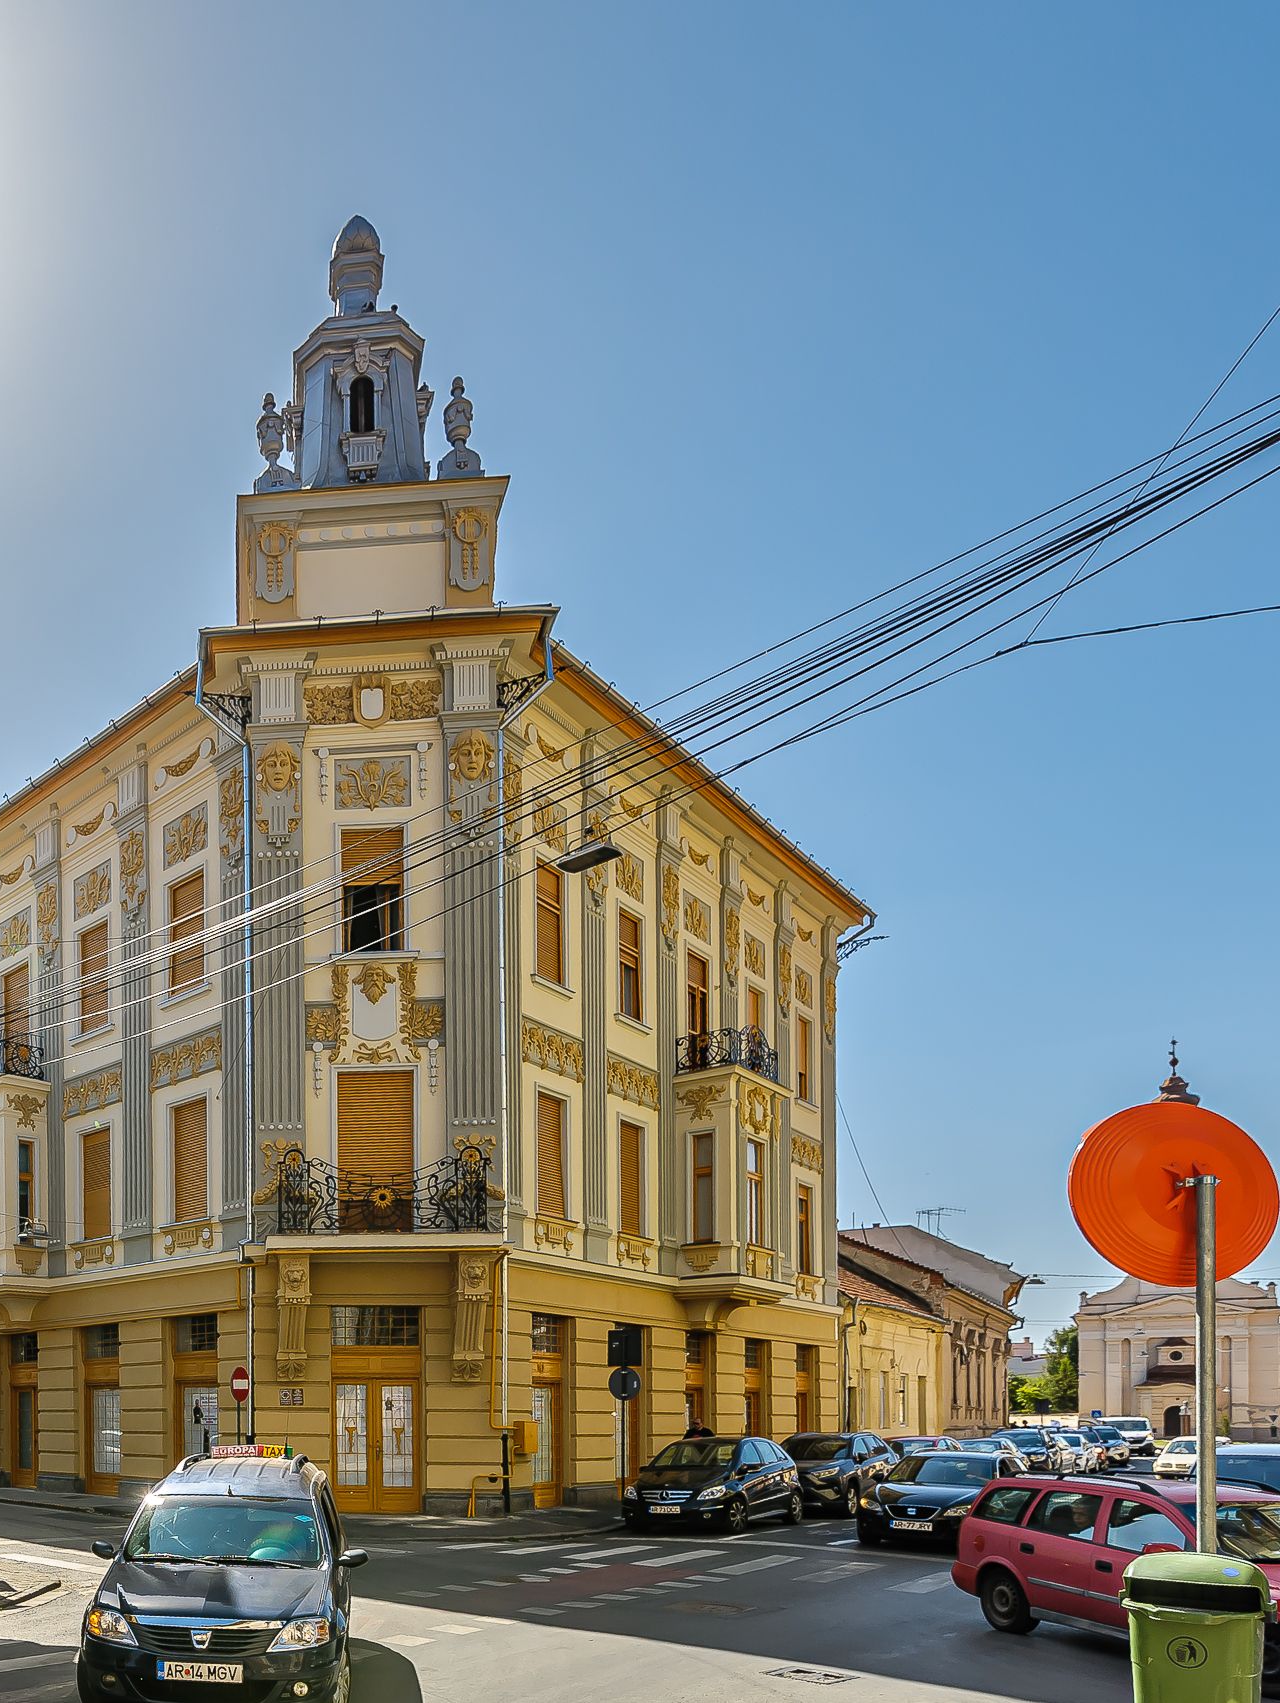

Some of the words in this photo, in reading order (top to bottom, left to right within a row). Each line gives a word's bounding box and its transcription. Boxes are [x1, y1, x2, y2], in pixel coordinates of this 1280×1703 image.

[213, 1446, 256, 1455] EUROPA
[166, 1663, 184, 1678] AR
[190, 1664, 203, 1679] 14
[207, 1665, 237, 1680] MGV
